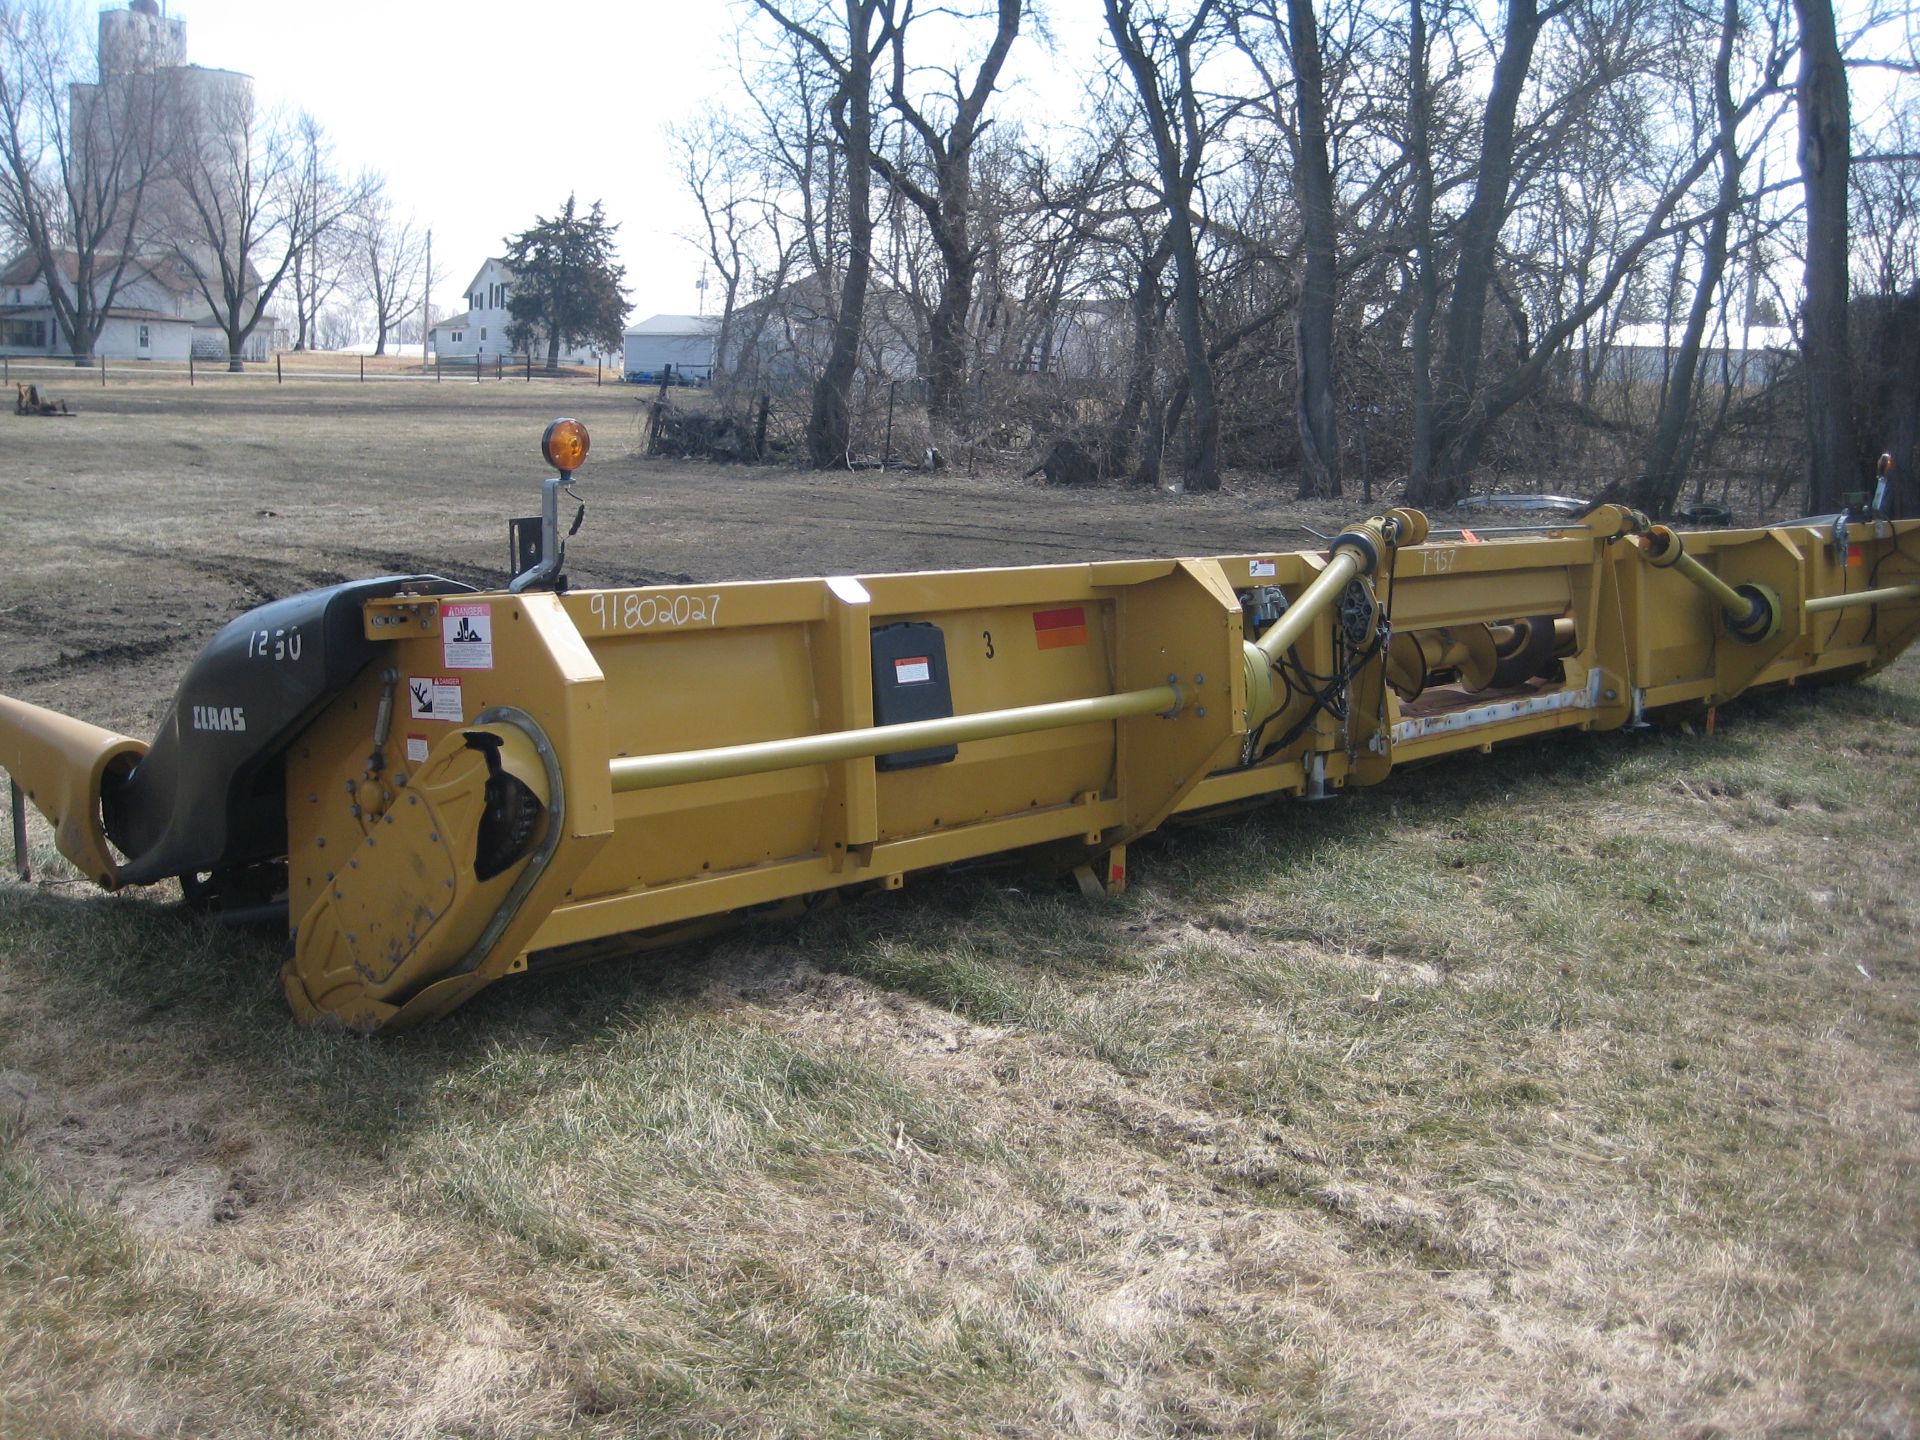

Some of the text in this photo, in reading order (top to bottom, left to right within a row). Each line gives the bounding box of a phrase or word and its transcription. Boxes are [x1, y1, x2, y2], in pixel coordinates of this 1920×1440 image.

[454, 606, 482, 616] DANGER
[590, 593, 721, 630] 91802027
[982, 630, 995, 659] 3
[193, 705, 246, 731] CLAAS
